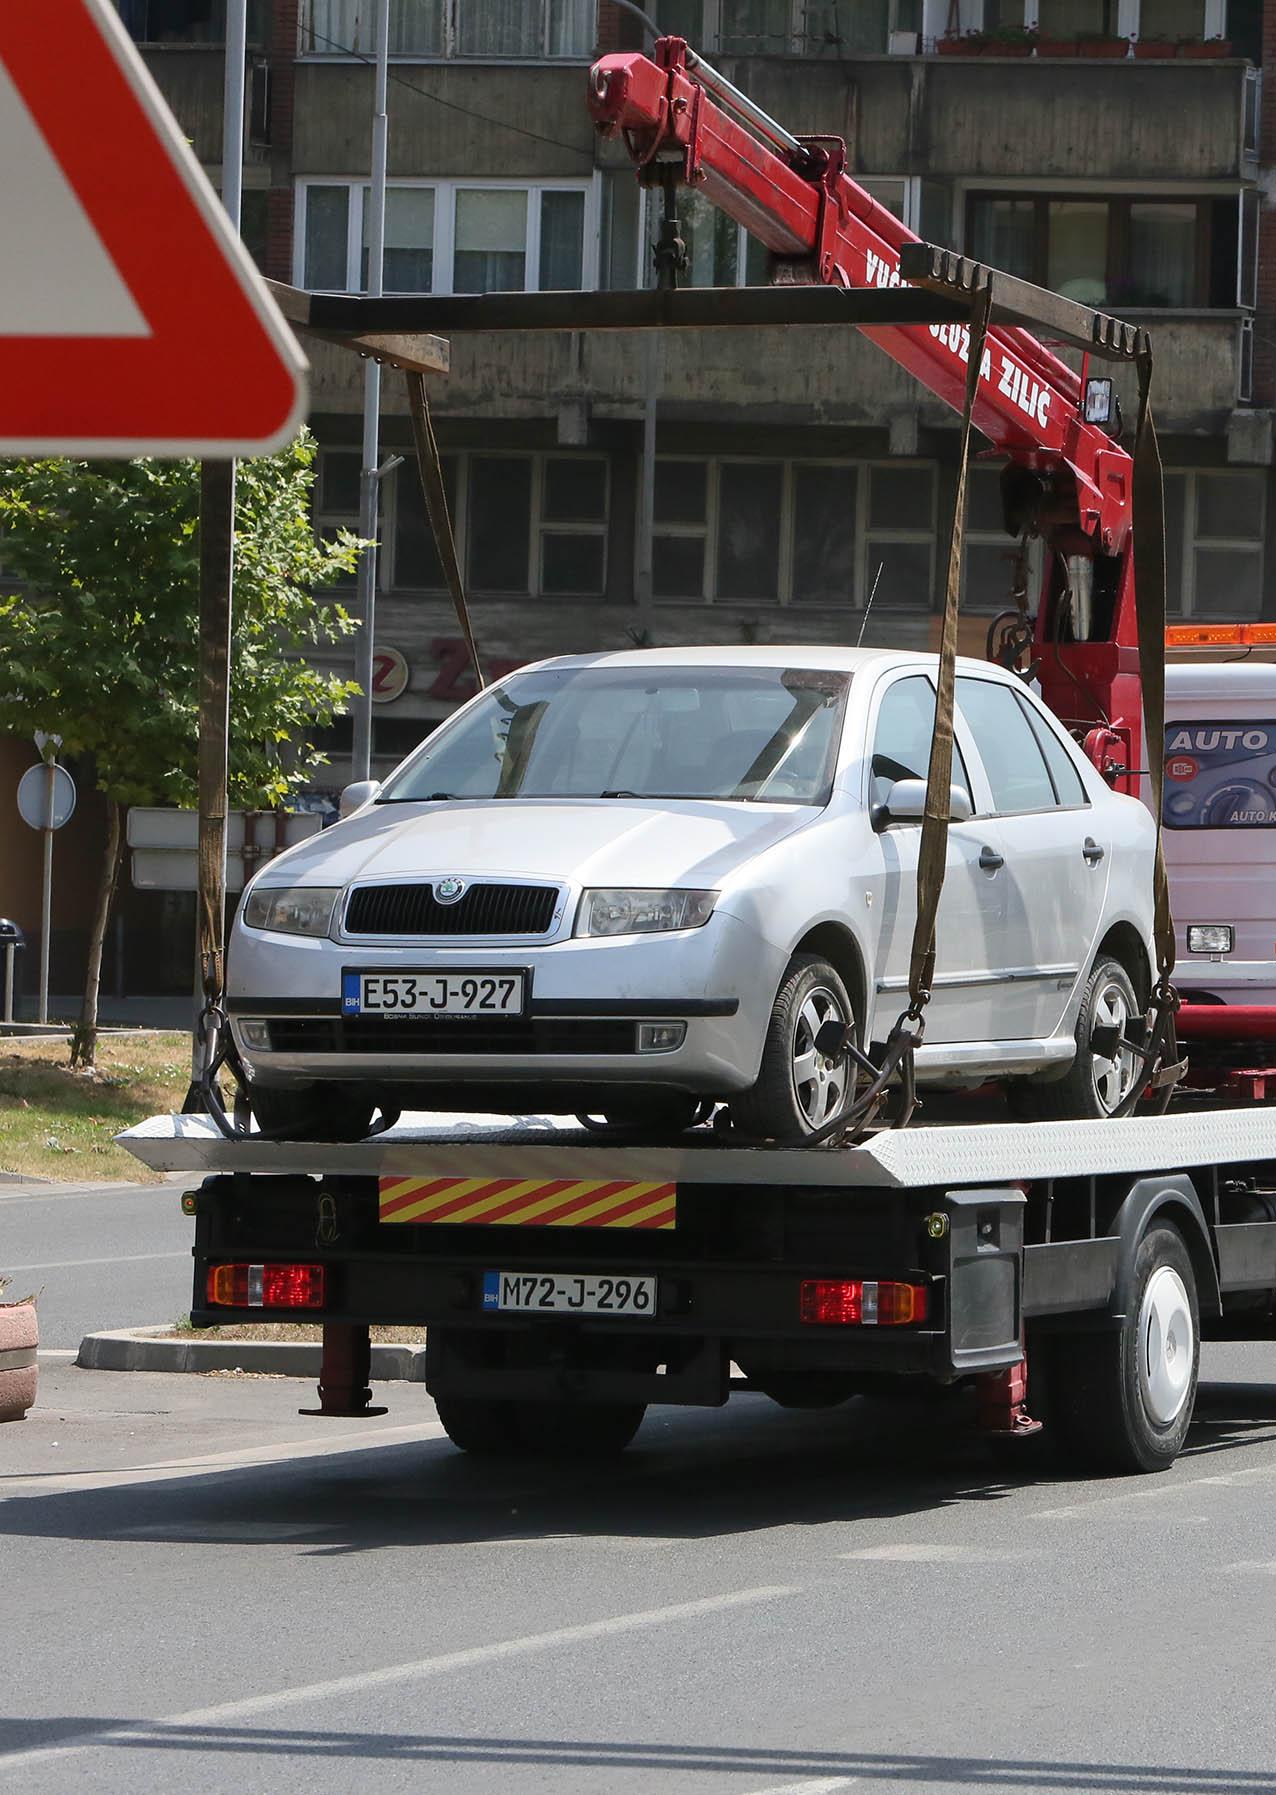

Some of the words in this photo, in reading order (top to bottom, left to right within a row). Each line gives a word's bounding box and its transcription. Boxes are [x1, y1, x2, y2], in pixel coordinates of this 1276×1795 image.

[866, 248, 913, 288] VUČ
[998, 354, 1052, 429] ZILIĆ
[1169, 731, 1268, 750] AUTO
[1230, 810, 1266, 822] AUTO
[345, 997, 360, 1007] BIH
[364, 978, 516, 1010] E53-J-927
[503, 1276, 650, 1310] M72-J-296
